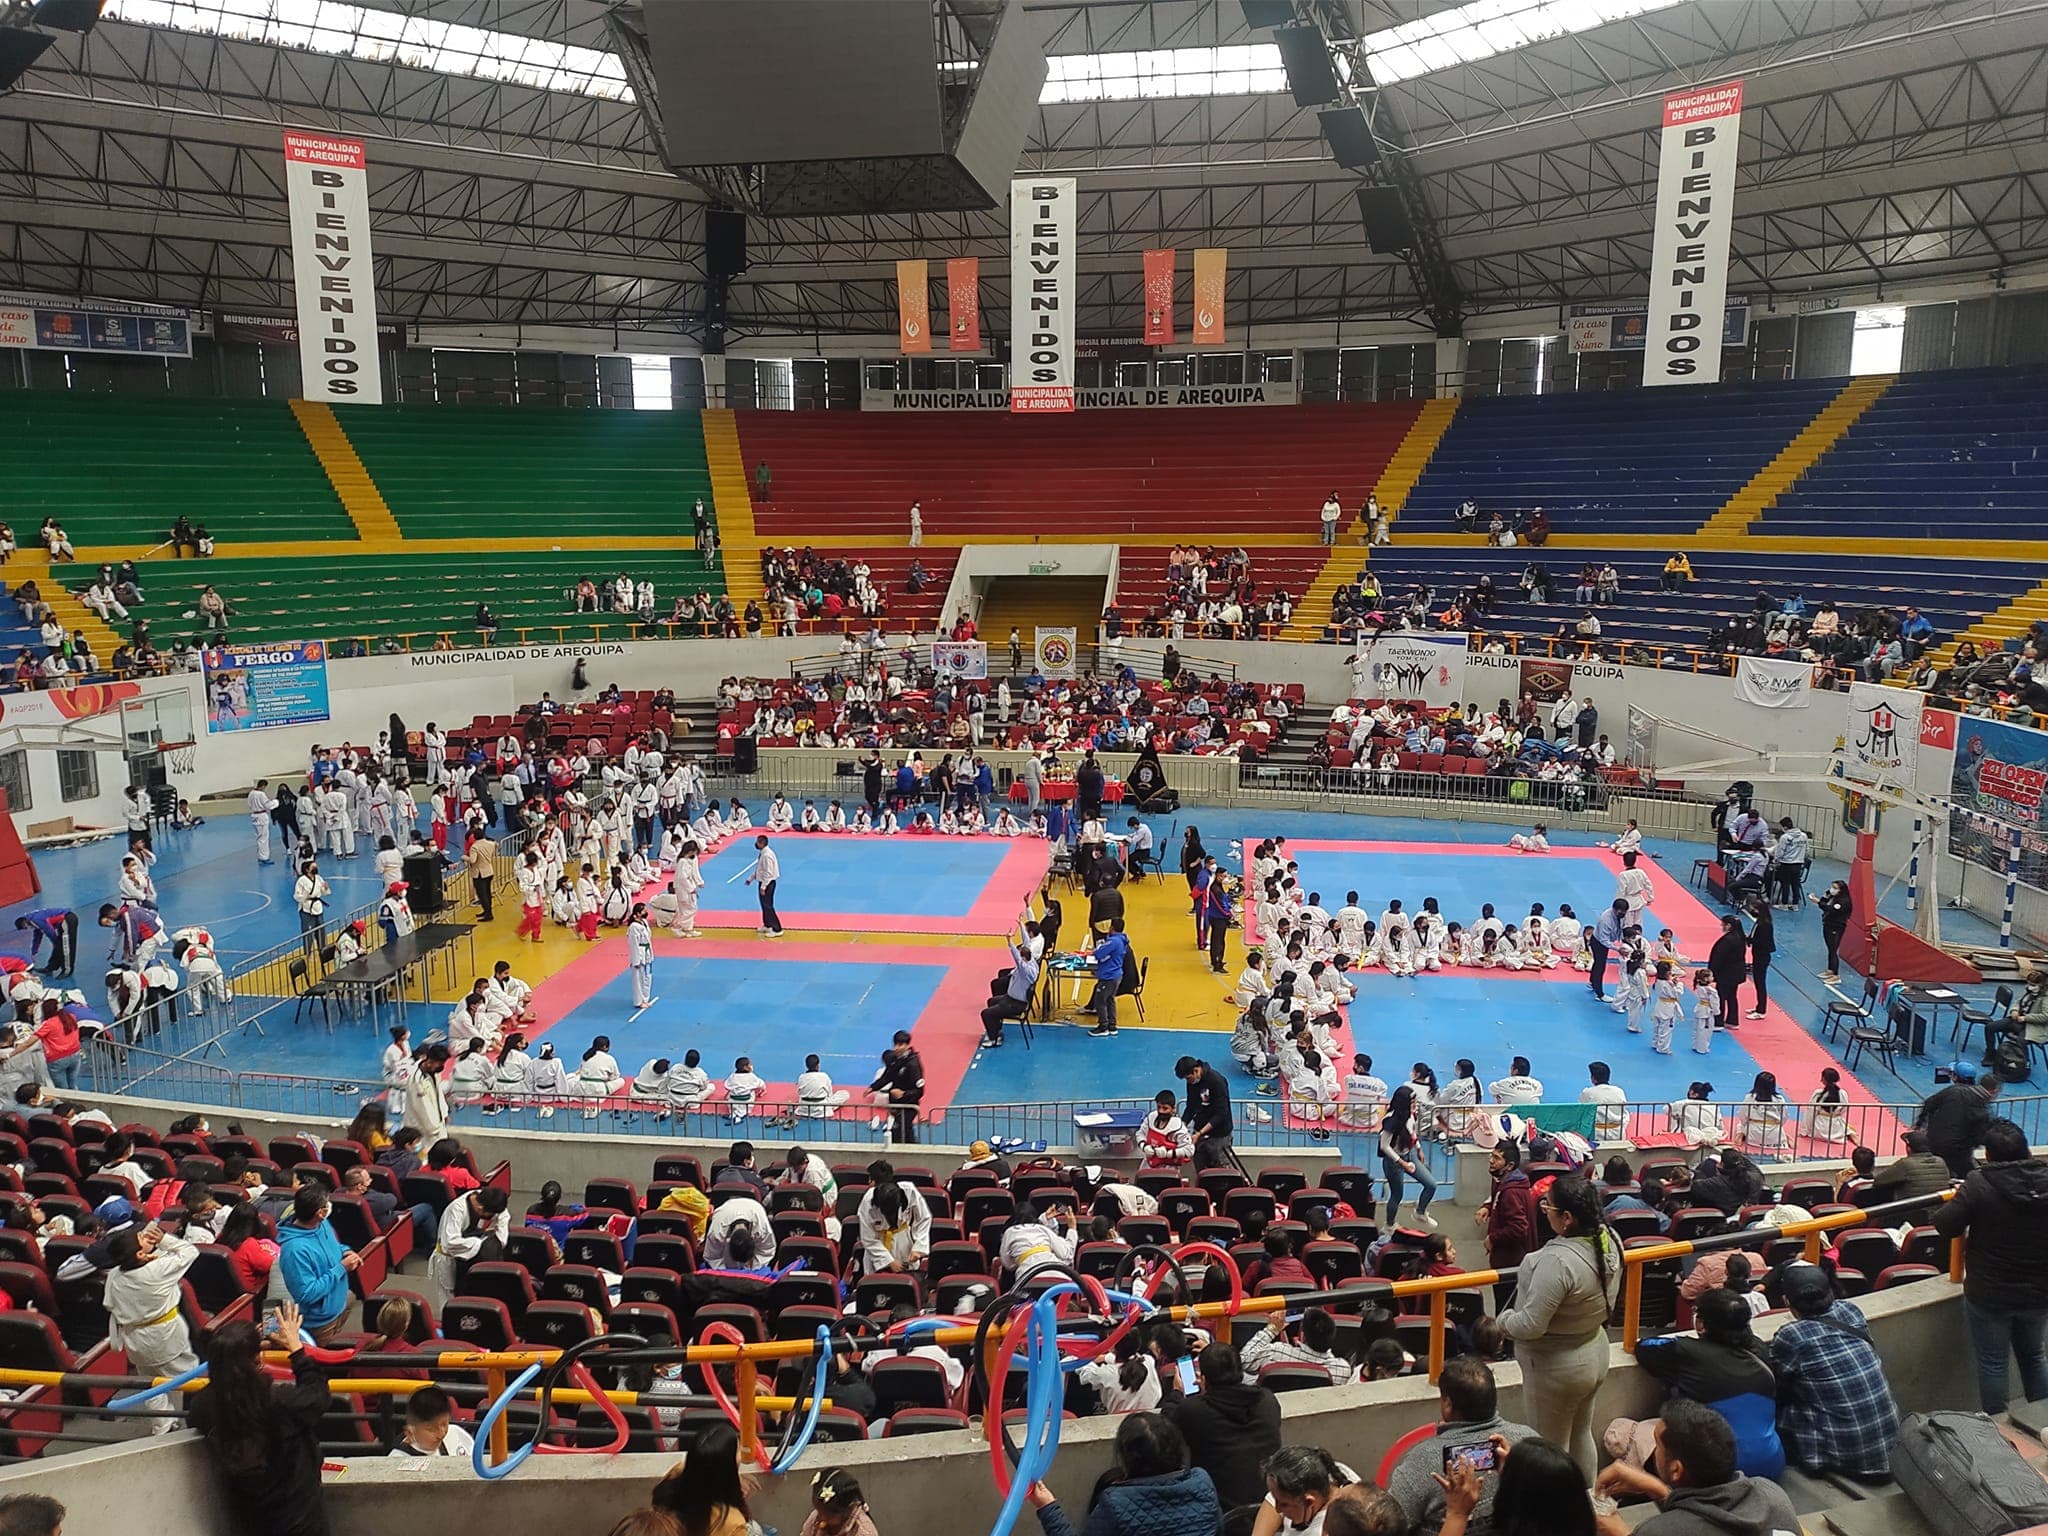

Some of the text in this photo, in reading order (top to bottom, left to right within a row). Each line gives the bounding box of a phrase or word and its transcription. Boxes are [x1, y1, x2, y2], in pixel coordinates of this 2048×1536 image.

[1668, 88, 1739, 110] MUNICIPALIDAD
[1672, 101, 1732, 121] DE AREQUIPA
[287, 137, 361, 154] MUNICIPALIDAD
[294, 148, 356, 164] DE AREQUIPA
[1666, 126, 1716, 376] BIENVENIDOS
[311, 170, 360, 395] BIENVENIDOS
[1030, 186, 1060, 382] BIENVENIDOS
[1, 311, 29, 320] caso
[143, 307, 187, 316] AREQUIPA
[223, 315, 293, 328] MUNICIPALIDAD
[1586, 320, 1608, 329] caso
[0, 332, 27, 343] ismo
[1574, 340, 1603, 350] Sismo
[893, 393, 1012, 409] MUNICIPALIDA
[1145, 390, 1169, 405] DE
[1177, 387, 1265, 405] AREQUIPA
[1012, 388, 1073, 399] MUNICIPALIDAD
[1016, 399, 1069, 409] DE AREQUIPA
[234, 652, 294, 666] FERGO
[411, 645, 624, 666] MUNICIPALIDAD DE AREQUIPA
[1387, 648, 1436, 657] TAEKWONDO
[1574, 664, 1625, 680] EQUIPA
[1857, 751, 1870, 763] TAE
[1891, 758, 1902, 768] DO
[2004, 764, 2046, 788] OPEN
